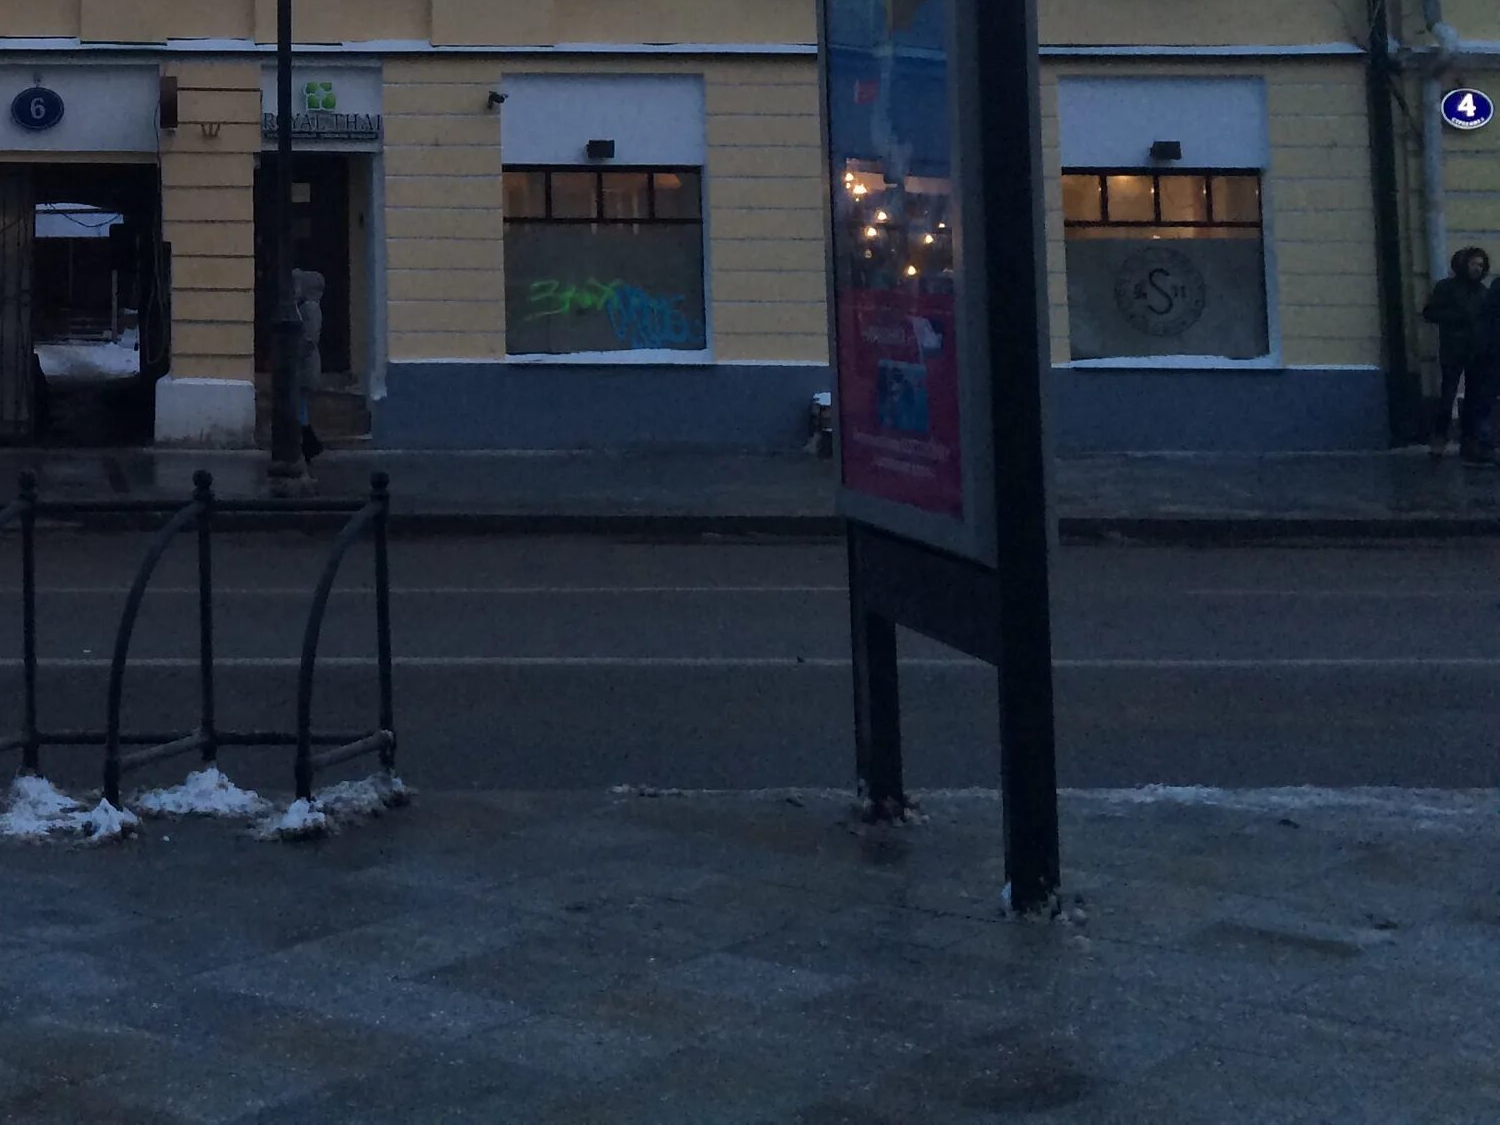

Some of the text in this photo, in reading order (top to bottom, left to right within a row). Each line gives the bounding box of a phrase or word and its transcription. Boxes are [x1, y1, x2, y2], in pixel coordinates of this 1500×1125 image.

[30, 97, 46, 120] 6
[1457, 93, 1477, 117] 4
[262, 112, 382, 132] RYAL THAI
